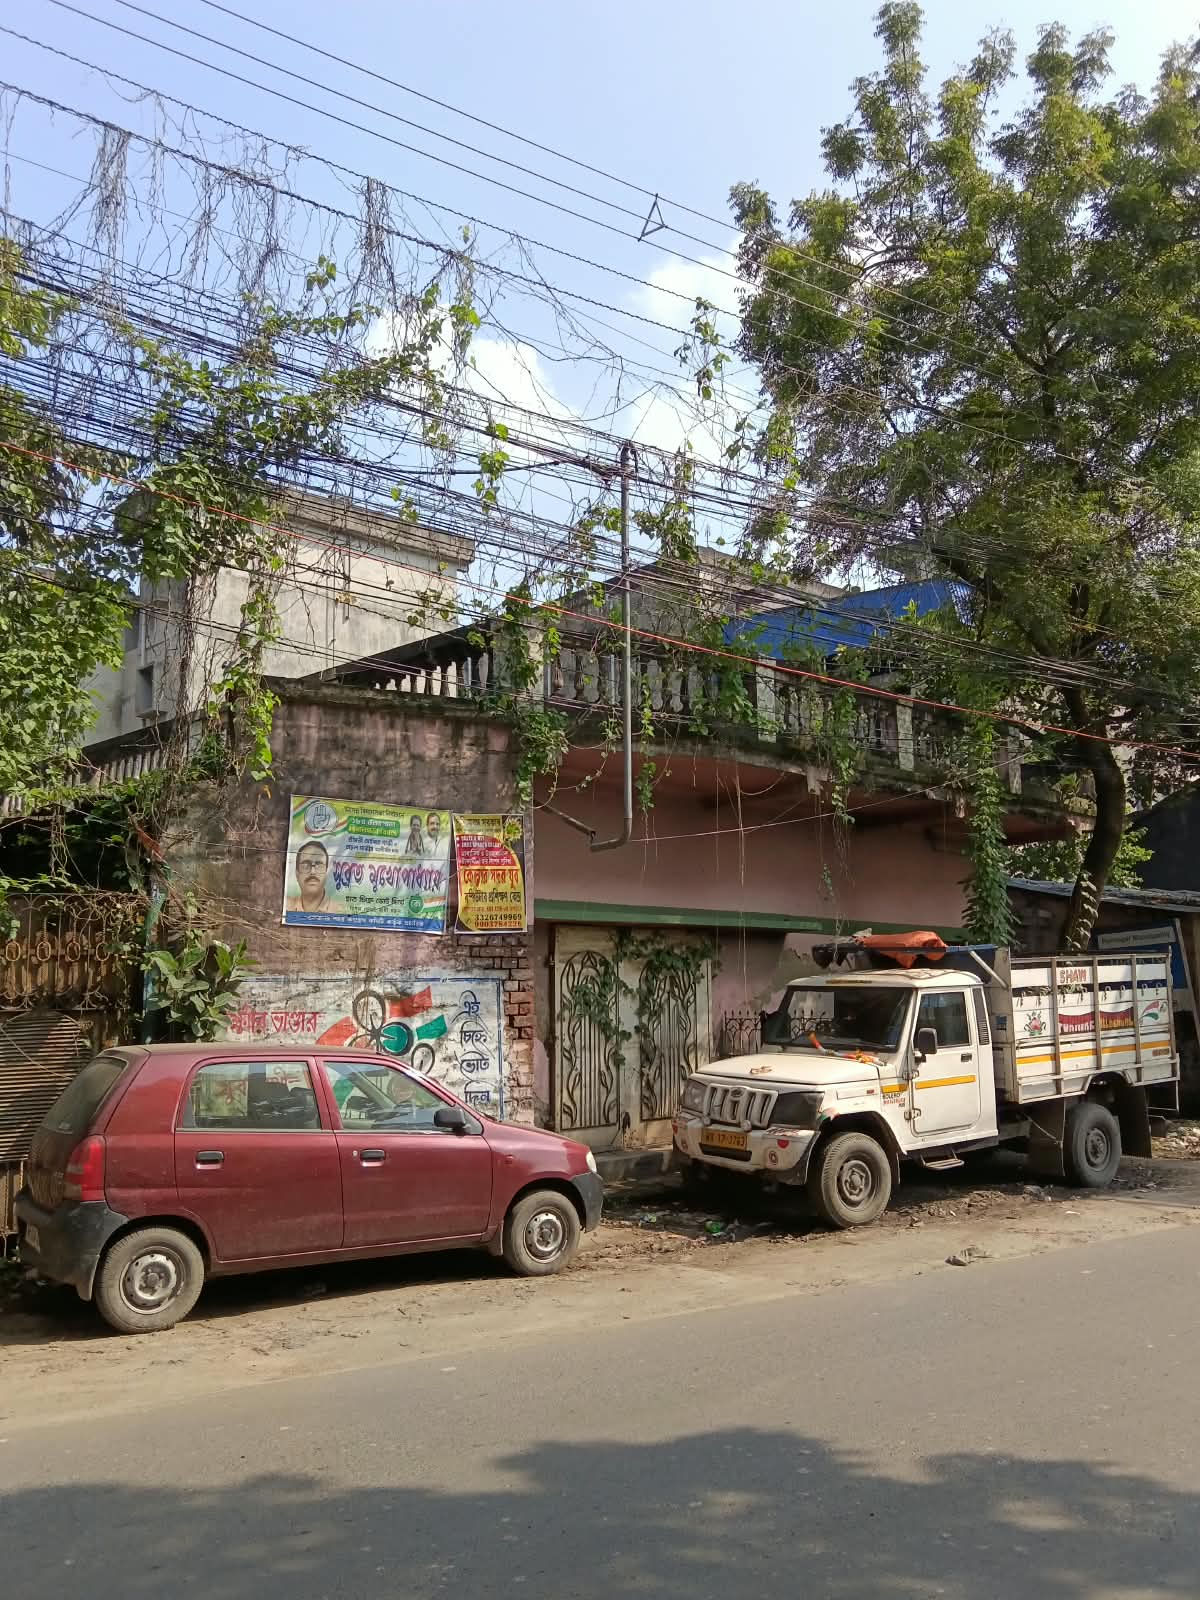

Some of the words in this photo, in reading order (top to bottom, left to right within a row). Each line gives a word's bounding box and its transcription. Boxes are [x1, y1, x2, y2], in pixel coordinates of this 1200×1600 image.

[333, 860, 365, 890] সুব্রত
[368, 864, 443, 893] মুখোপাধ্যায়
[1059, 968, 1087, 984] SHAW
[461, 994, 481, 1016] এই
[271, 1009, 325, 1033] ভাণ্ডার
[460, 1021, 488, 1049] চিহ্নে
[460, 1052, 490, 1076] ভোট
[463, 1083, 491, 1105] দিন
